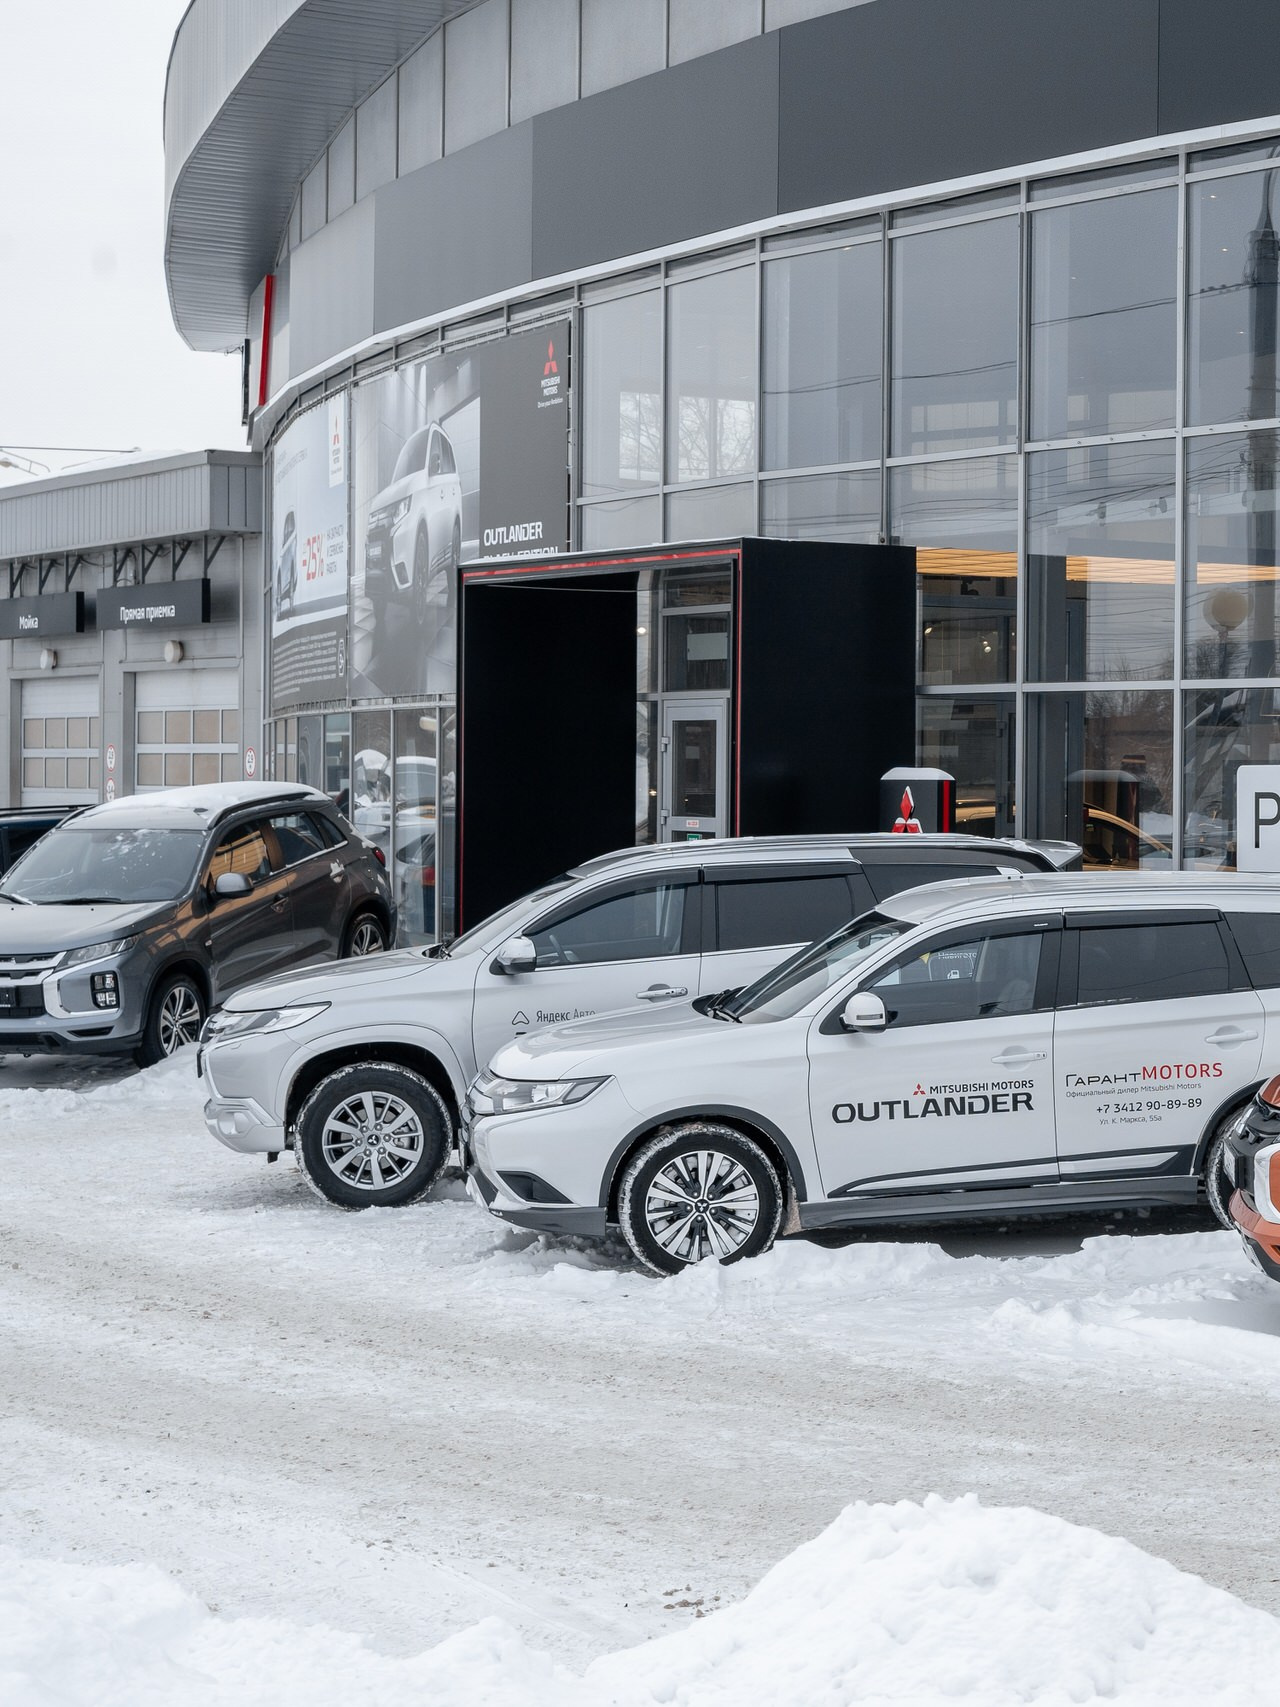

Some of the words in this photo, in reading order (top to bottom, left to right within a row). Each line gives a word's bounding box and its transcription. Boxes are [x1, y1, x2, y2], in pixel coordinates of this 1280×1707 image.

[483, 521, 543, 547] OUTLANDER
[19, 614, 39, 630] Мойка
[119, 606, 146, 624] Прямая
[146, 604, 176, 622] приемка
[536, 1010, 571, 1024] Яндекс
[929, 1083, 989, 1095] MITSUBISHI
[991, 1079, 1034, 1091] MOTORS
[1065, 1087, 1116, 1099] Официальный
[1117, 1087, 1139, 1095] дилер
[1140, 1084, 1175, 1093] Mitsubishi
[1176, 1082, 1202, 1090] Motors
[831, 1091, 1035, 1124] OUTLANDER
[1096, 1104, 1110, 1114] +7
[1113, 1102, 1143, 1113] 3412
[1146, 1097, 1203, 1110] 90-89-89
[1119, 1115, 1148, 1125] Маркса,
